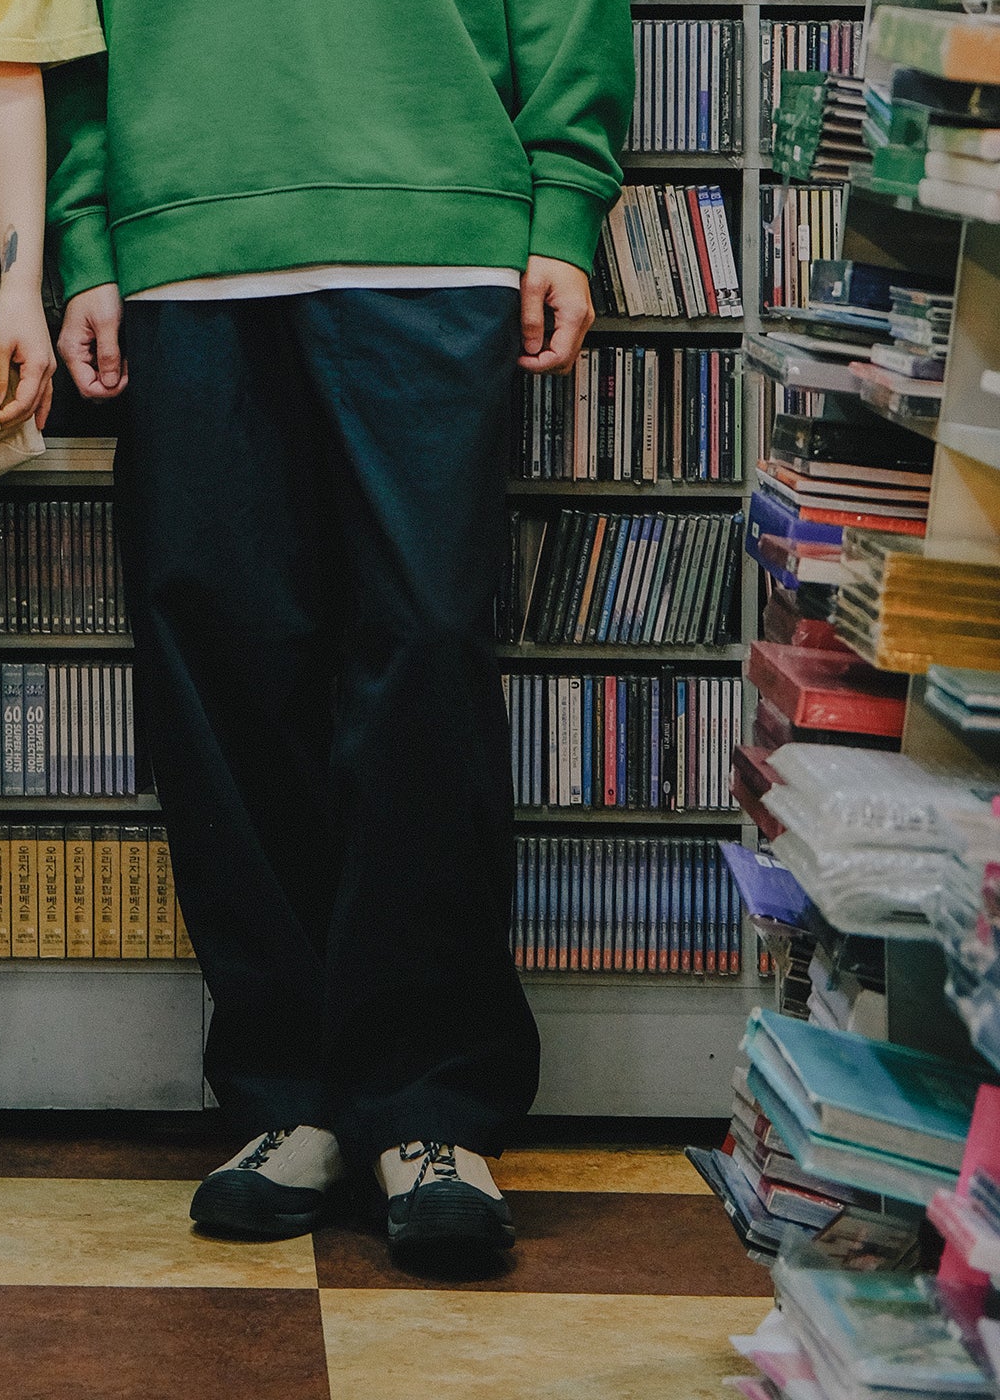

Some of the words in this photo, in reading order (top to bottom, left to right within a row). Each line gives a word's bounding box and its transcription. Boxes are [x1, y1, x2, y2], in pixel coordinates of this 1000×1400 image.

[607, 376, 615, 398] LOVE
[5, 705, 22, 722] 60
[27, 705, 43, 722] 60
[5, 724, 13, 773] COLLECTION
[13, 724, 22, 752] SUPER
[27, 724, 35, 773] COLLECTION
[35, 724, 43, 752] SUPER
[13, 753, 22, 773] HITS
[35, 753, 43, 773] HITS
